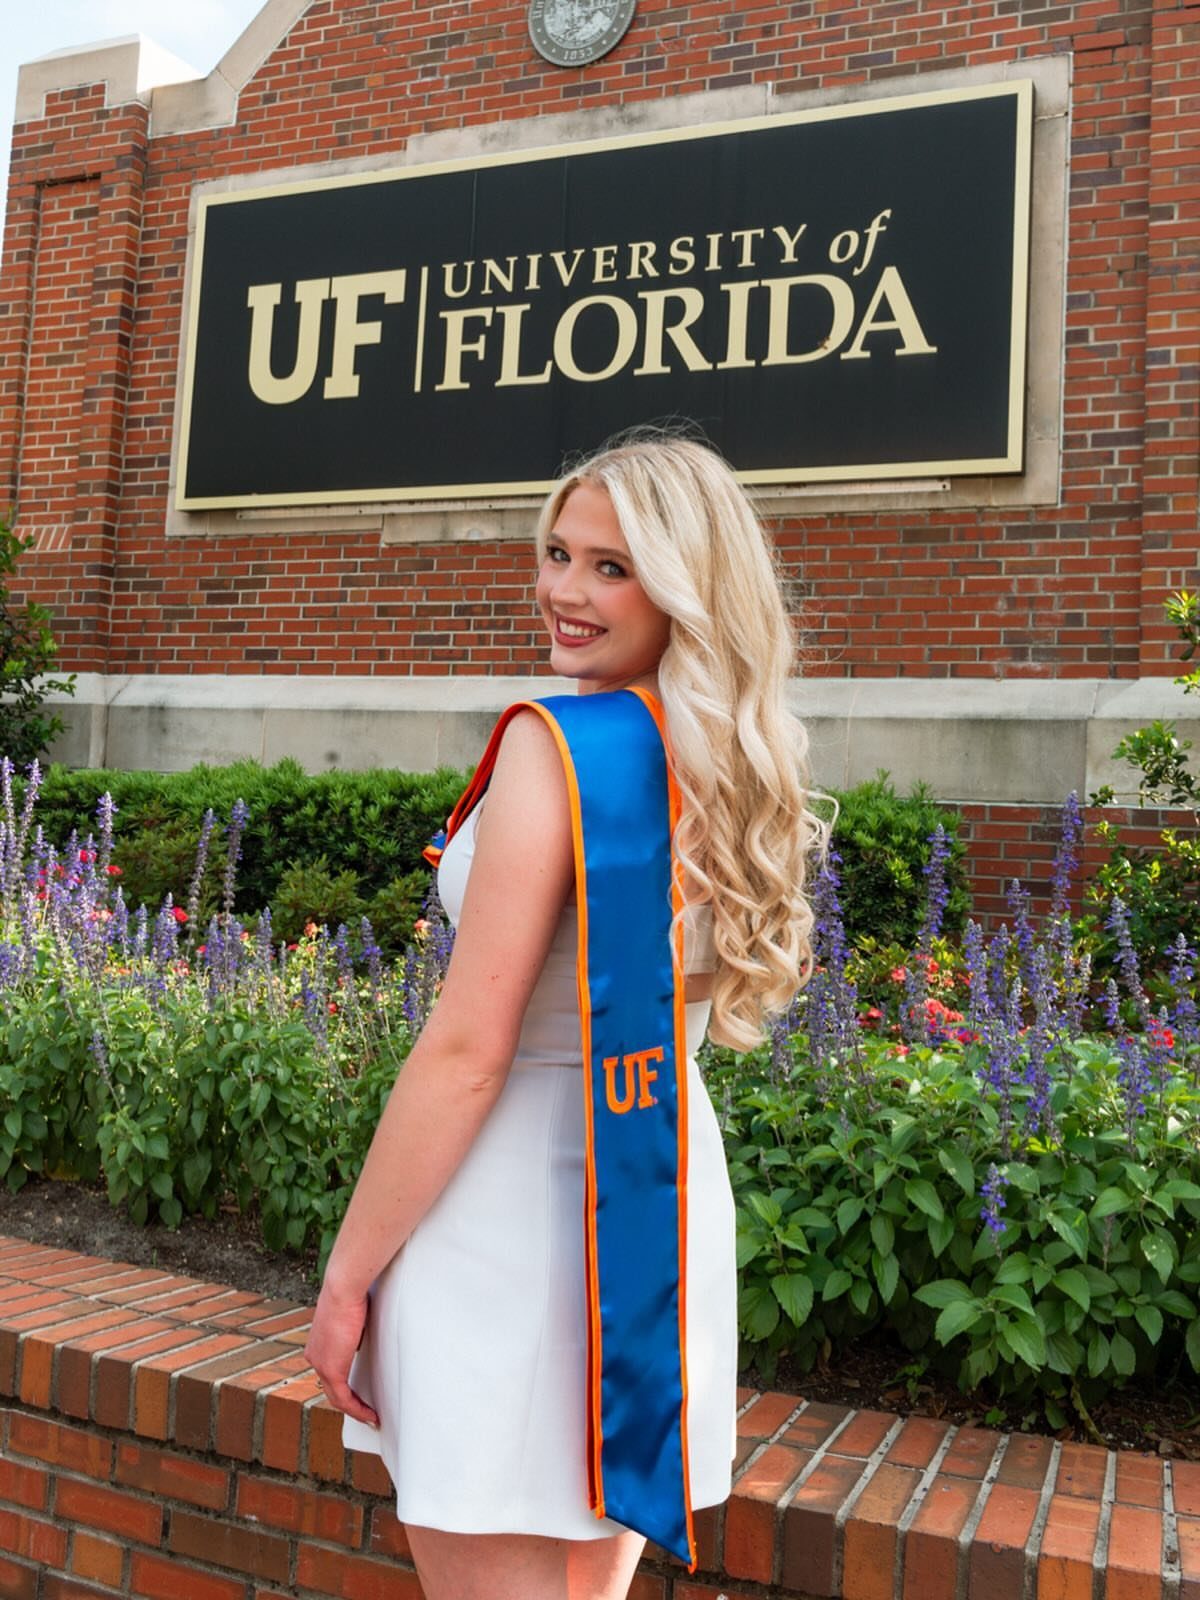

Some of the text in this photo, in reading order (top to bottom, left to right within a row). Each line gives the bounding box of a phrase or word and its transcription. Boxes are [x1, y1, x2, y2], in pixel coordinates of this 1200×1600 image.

[443, 208, 892, 298] UNIVERSITY of
[247, 268, 407, 405] UF
[434, 266, 938, 392] FLORIDA
[603, 1046, 664, 1115] UF
